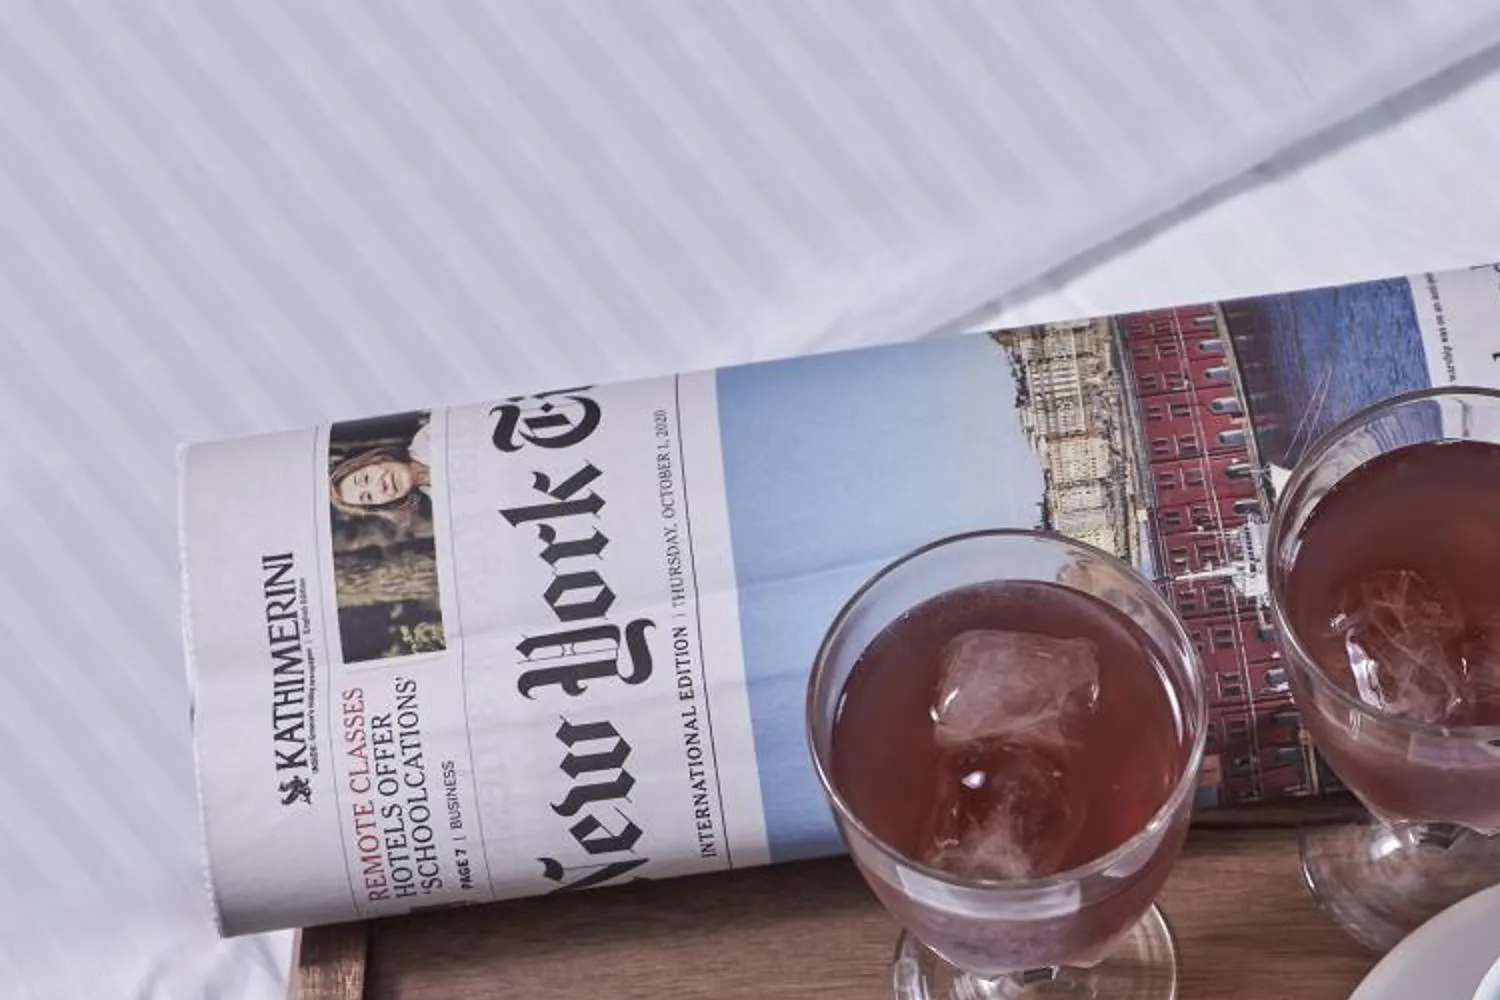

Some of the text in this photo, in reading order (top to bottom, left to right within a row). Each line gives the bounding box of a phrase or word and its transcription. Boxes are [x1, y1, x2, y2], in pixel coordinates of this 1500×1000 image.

[653, 408, 669, 437] 2020
[656, 453, 678, 518] OCTOBER
[498, 456, 656, 701] York
[262, 552, 308, 772] KATHIMERINI
[672, 624, 695, 702] EDITION
[342, 686, 391, 903] REMOTE CLASSES
[371, 712, 418, 899] HOTELS OFFER
[441, 760, 474, 889] PAGE 7 BUSINESS
[681, 704, 718, 859] INTERNATIONAL
